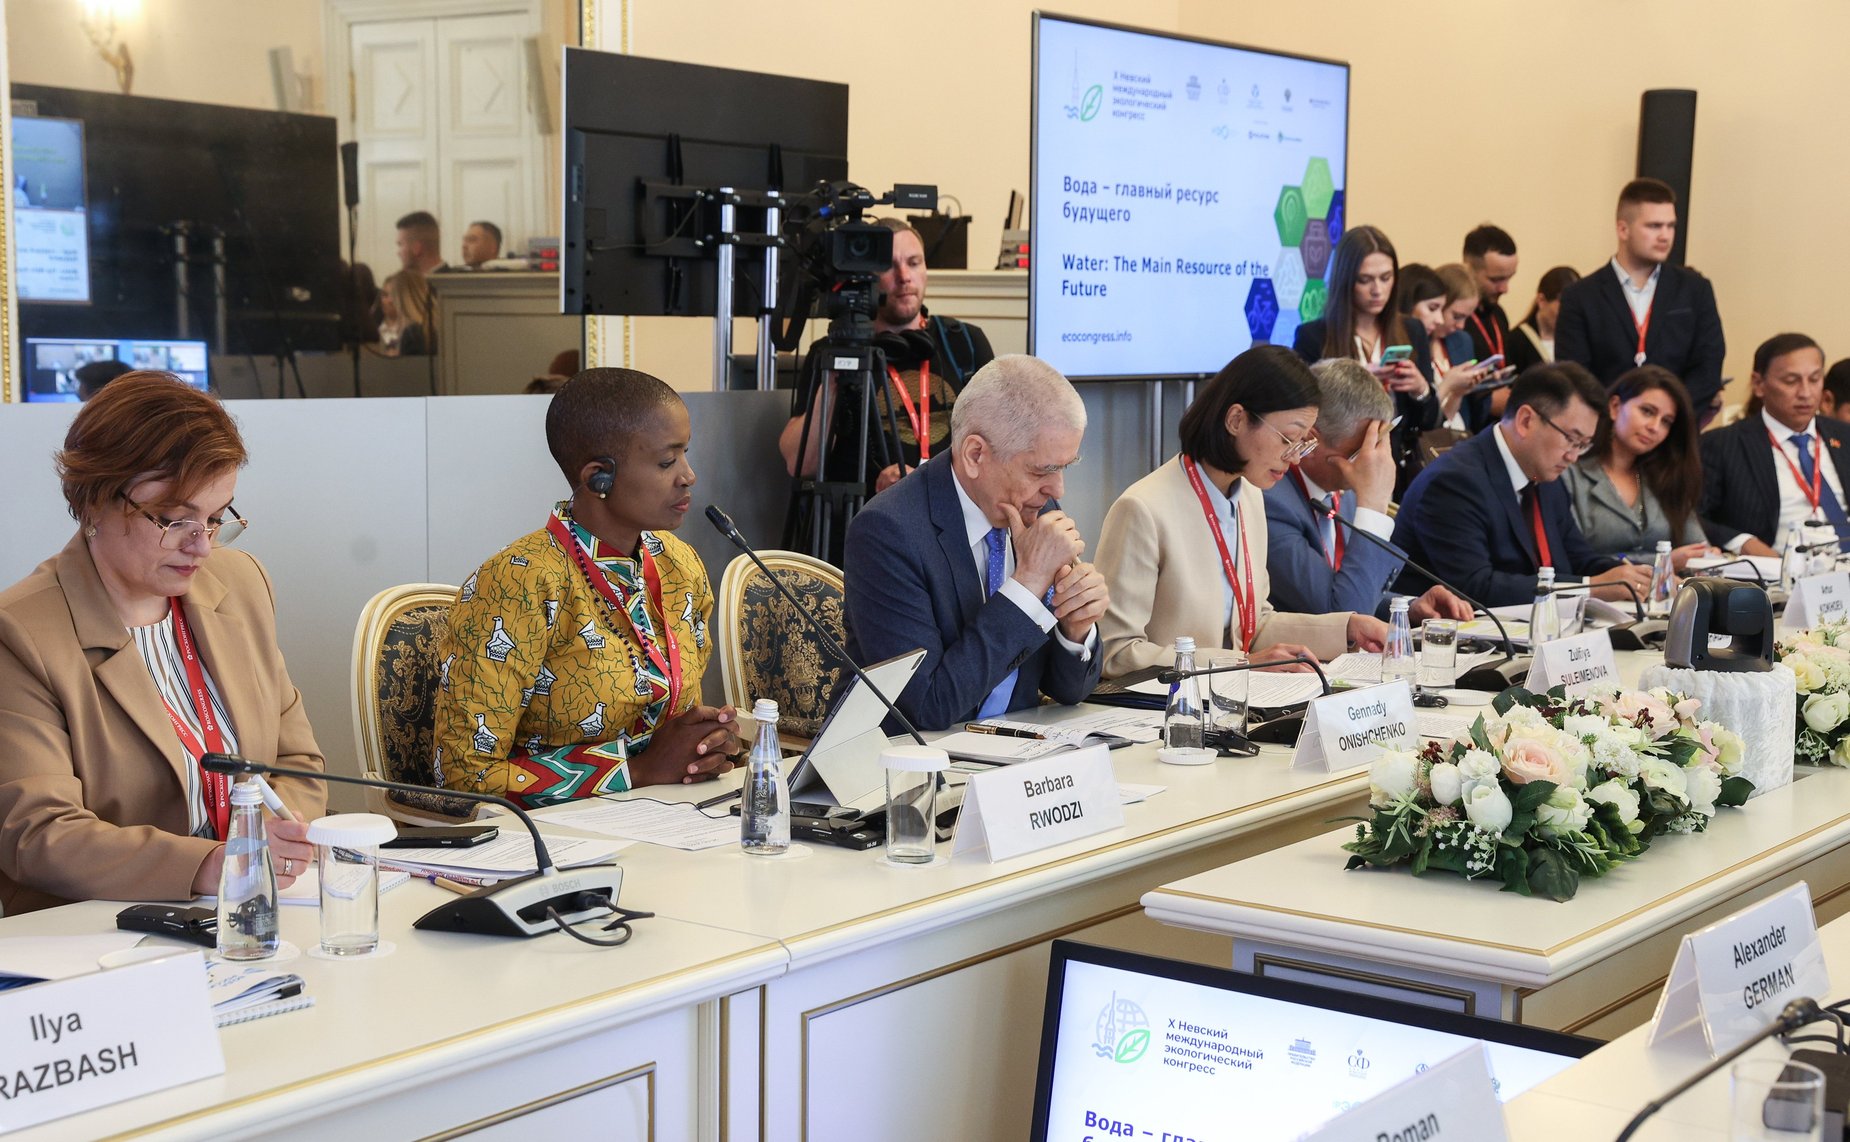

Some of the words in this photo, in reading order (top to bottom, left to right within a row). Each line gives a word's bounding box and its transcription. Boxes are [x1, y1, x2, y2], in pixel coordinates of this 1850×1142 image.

[1113, 85, 1172, 99] международный
[1112, 110, 1145, 121] конгресс
[1113, 97, 1166, 111] экологический
[1063, 176, 1098, 195] Вода
[1115, 183, 1172, 200] главный
[1176, 188, 1219, 205] ресурс
[1063, 202, 1131, 224] будущего
[1062, 254, 1108, 272] Water:
[1113, 256, 1137, 273] The
[1141, 257, 1171, 273] Main
[1176, 258, 1231, 276] Resource
[1235, 260, 1247, 276] of
[1250, 260, 1269, 277] the
[1062, 280, 1107, 297] Future
[1061, 331, 1133, 344] ecocongress.info
[1348, 700, 1387, 721] Gennady
[1339, 722, 1406, 751] ONISHCHENKO
[1024, 774, 1074, 798] Barbara
[1030, 800, 1084, 830] RWODZI
[552, 879, 581, 892] BOSCH
[1733, 924, 1787, 969] Alexander
[1743, 963, 1795, 1010] GERMAN
[29, 1012, 83, 1044] Ilya
[1178, 1020, 1228, 1040] Невский
[1164, 1044, 1252, 1070] экологический
[1165, 1032, 1264, 1060] международный
[1163, 1057, 1216, 1075] конгресс
[1085, 1110, 1134, 1137] Вода
